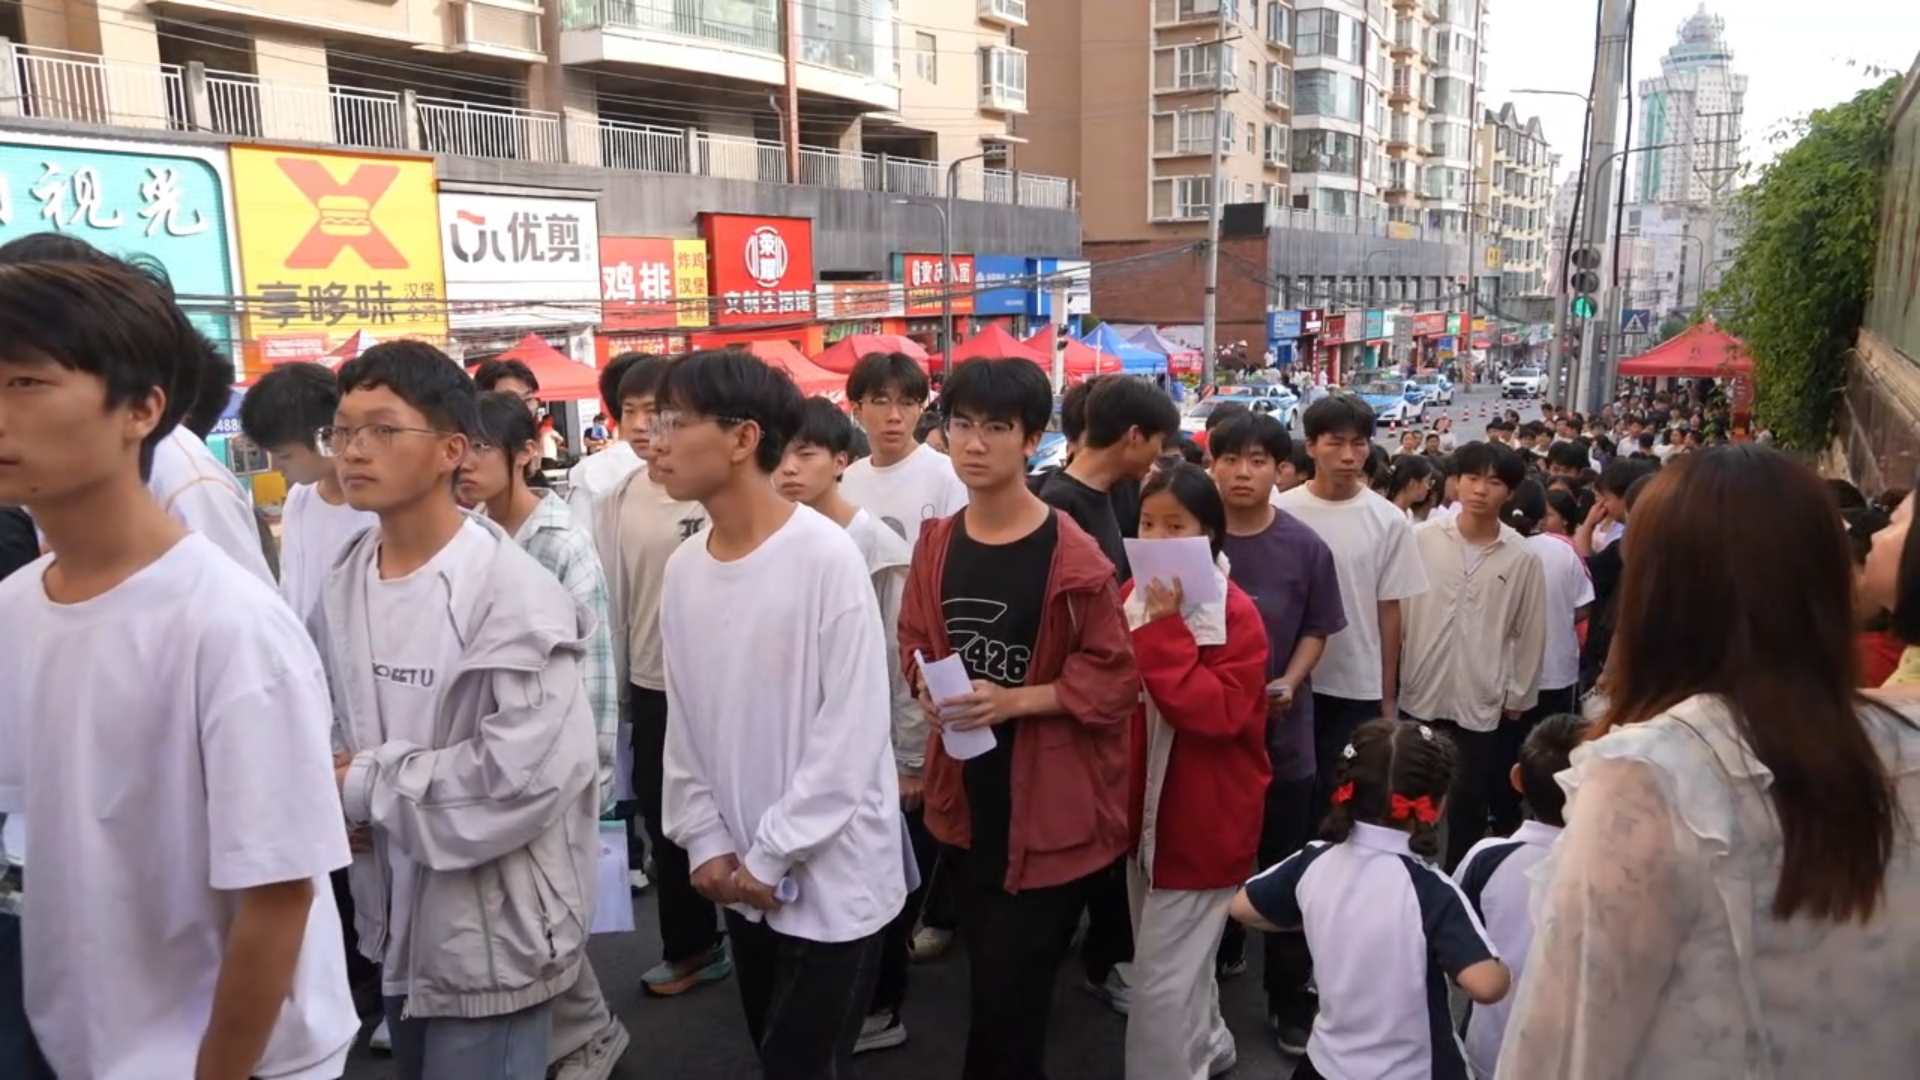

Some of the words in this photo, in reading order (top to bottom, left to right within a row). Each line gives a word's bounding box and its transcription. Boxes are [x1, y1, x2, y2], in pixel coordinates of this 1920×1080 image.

[0, 162, 207, 238] 视光
[507, 211, 580, 264] 优剪
[677, 251, 705, 270] 炸鸡
[257, 280, 396, 328] 享哆味
[403, 282, 436, 301] 汉堡
[602, 260, 672, 306] 鸡排
[679, 277, 706, 295] 汉堡
[965, 636, 1031, 683] 426
